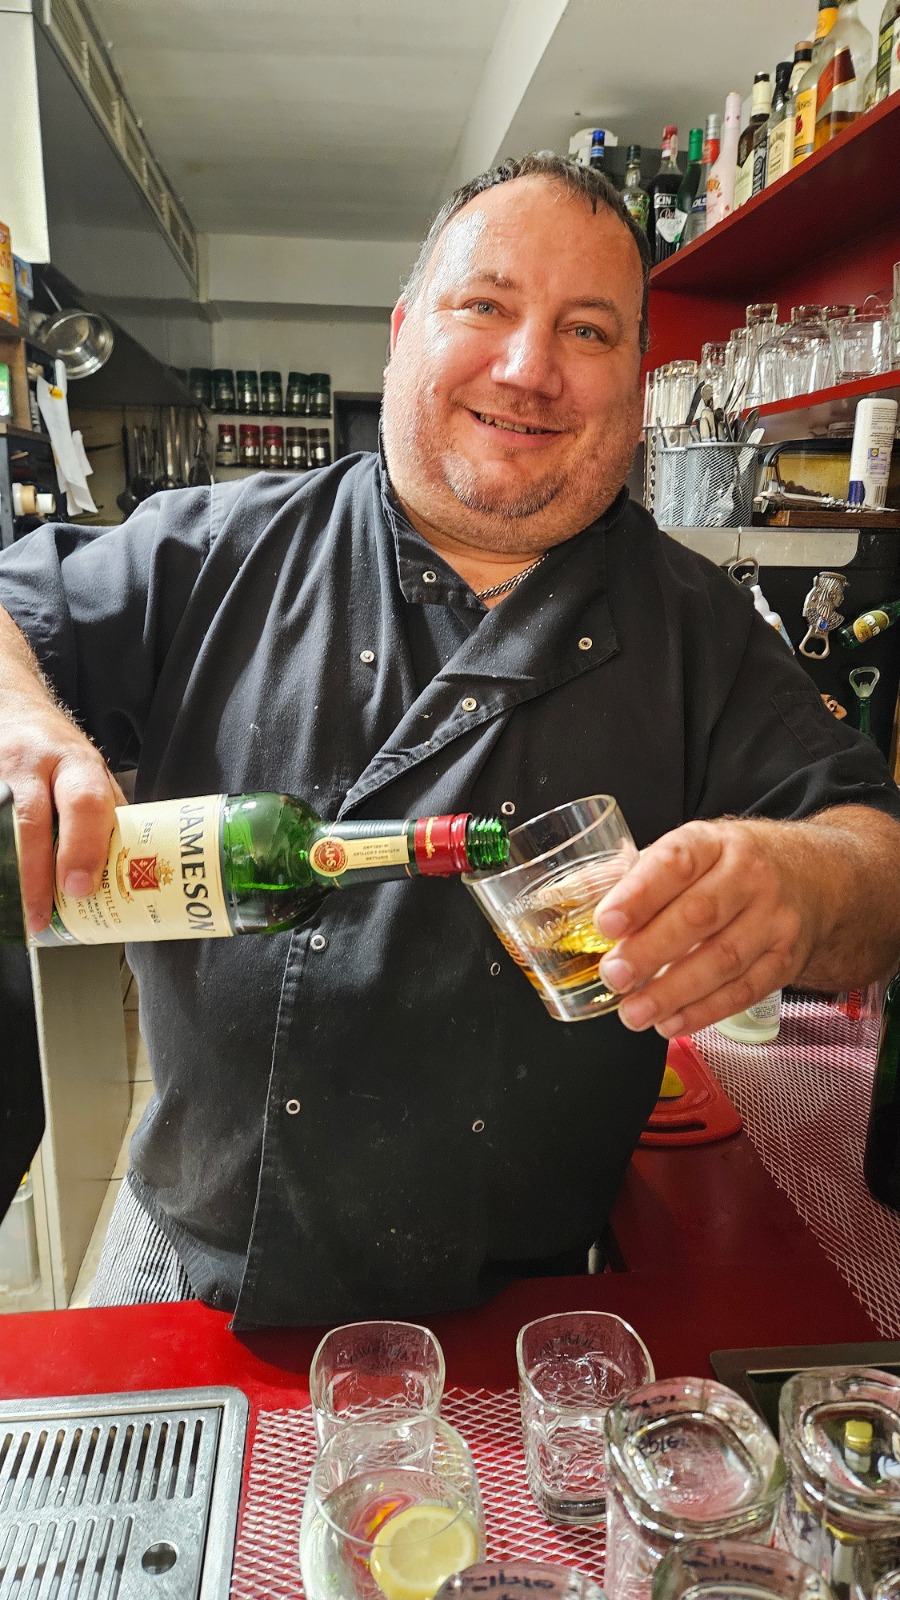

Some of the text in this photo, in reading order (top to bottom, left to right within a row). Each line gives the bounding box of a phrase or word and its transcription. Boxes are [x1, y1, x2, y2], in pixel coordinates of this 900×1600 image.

[179, 804, 217, 933] JAMESON
[101, 869, 122, 925] DISTILLED
[146, 903, 160, 925] 1780
